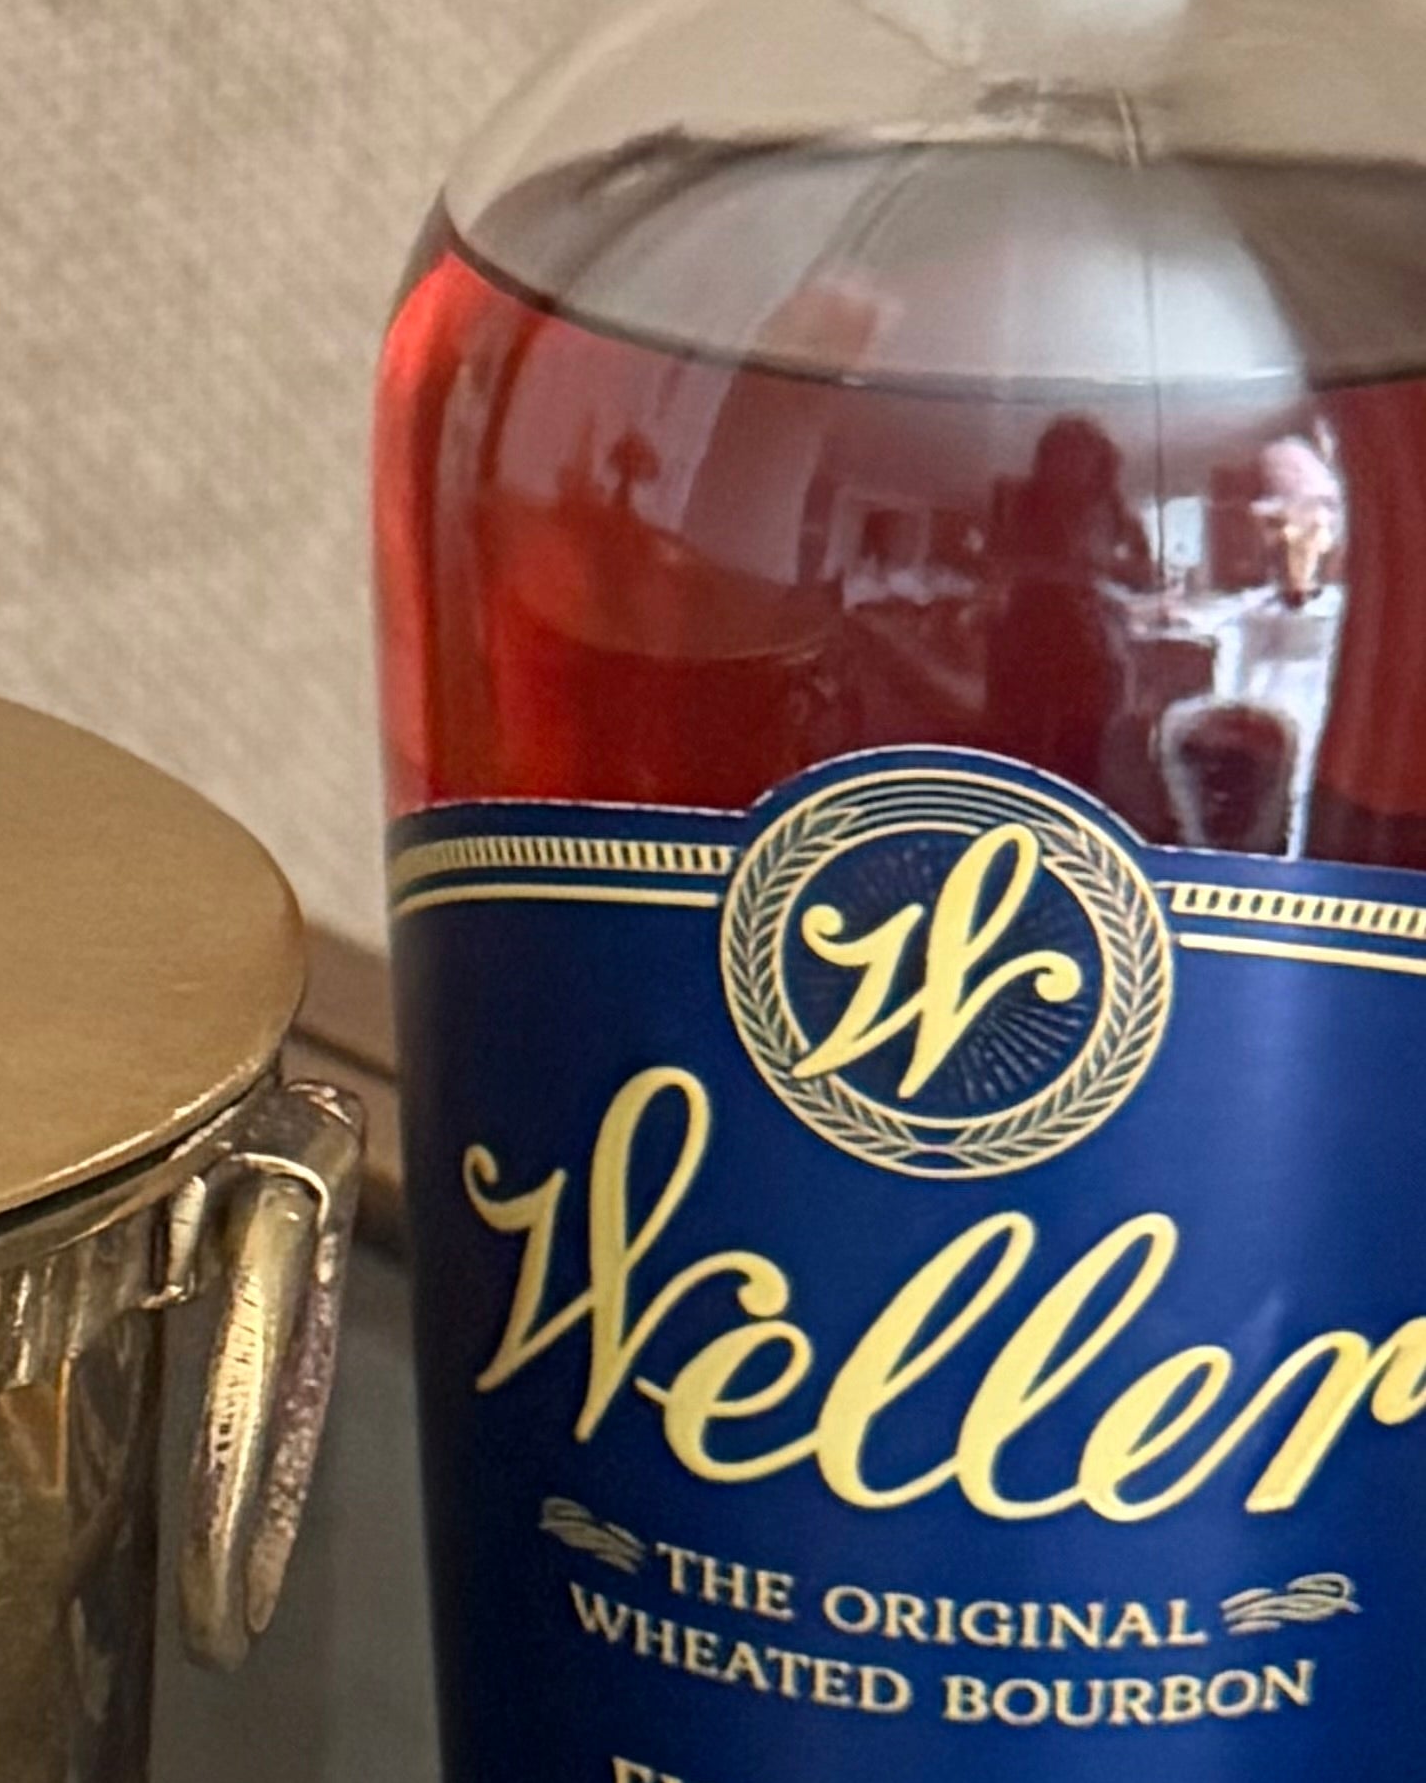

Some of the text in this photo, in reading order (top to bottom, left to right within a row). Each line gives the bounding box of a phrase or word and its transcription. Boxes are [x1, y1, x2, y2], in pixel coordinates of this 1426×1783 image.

[791, 823, 1082, 1097] W
[461, 1066, 1426, 1523] Weller
[567, 1581, 1316, 1726] WHEATED BOURBON
[655, 1541, 1207, 1648] THE ORIGINAL
